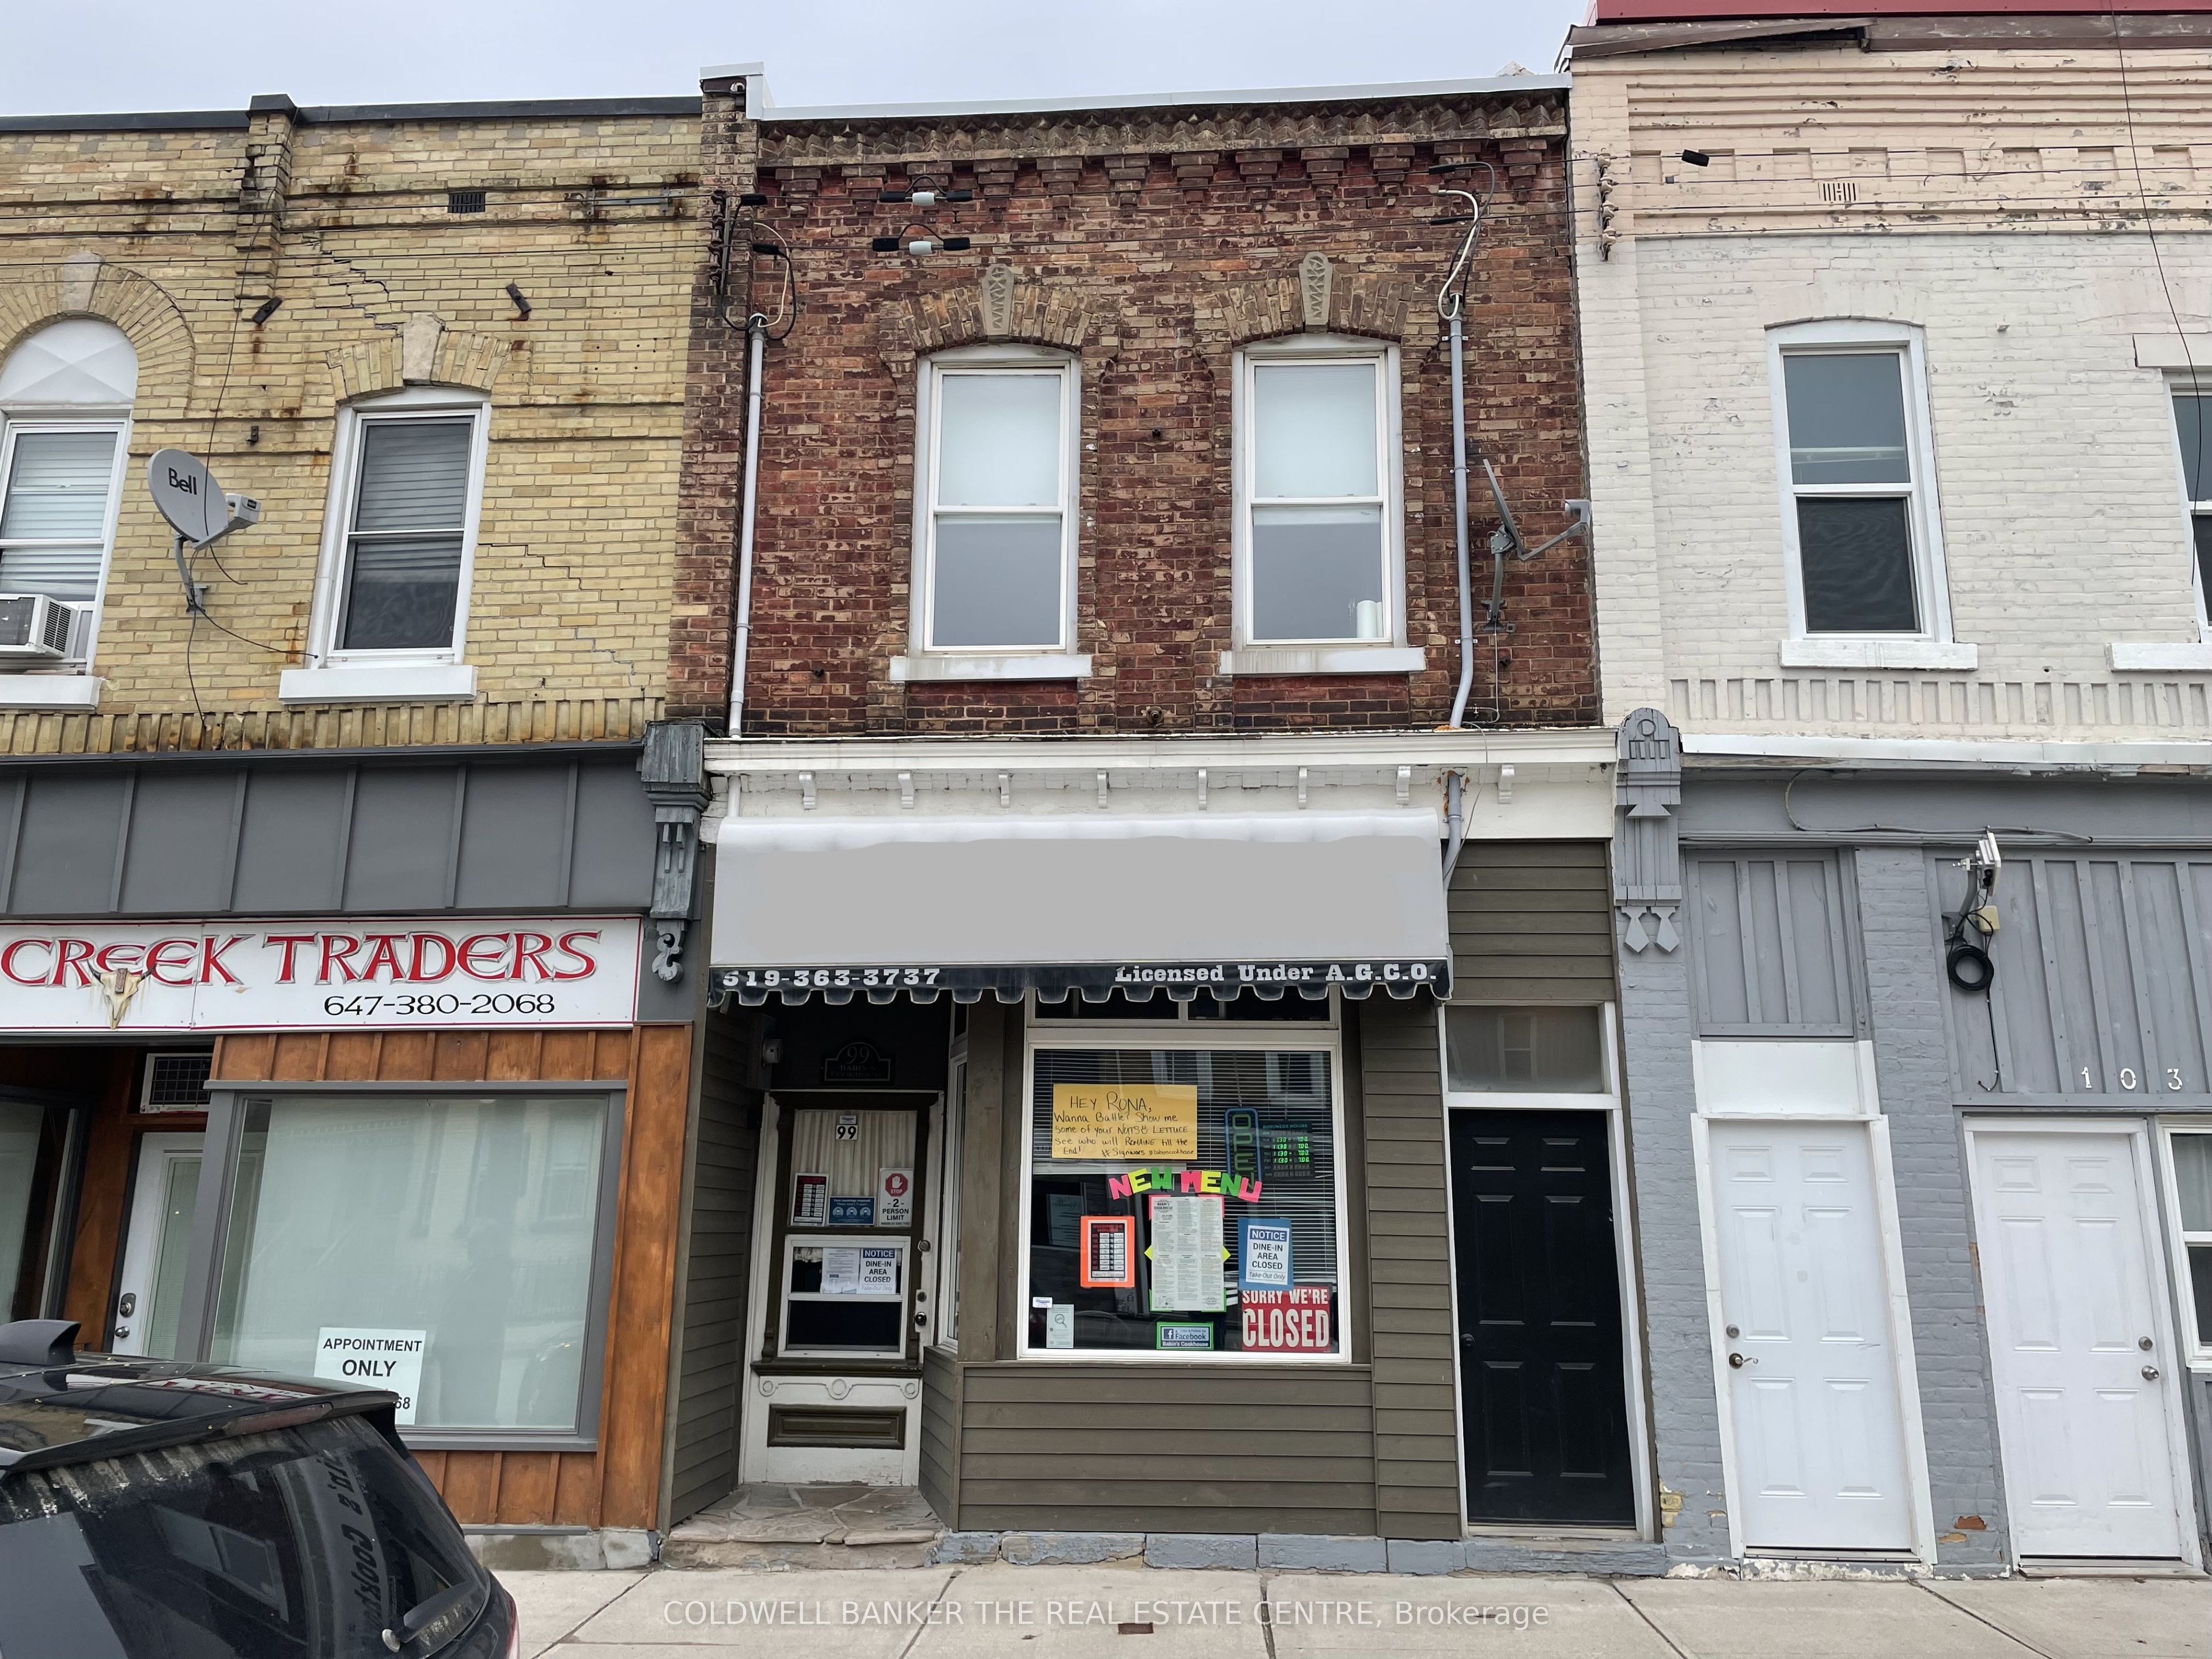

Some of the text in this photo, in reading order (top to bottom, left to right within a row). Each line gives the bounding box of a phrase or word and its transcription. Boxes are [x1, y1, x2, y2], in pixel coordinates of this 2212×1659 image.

[168, 467, 197, 495] Bell
[0, 929, 602, 989] CREEK TRADERS
[723, 968, 940, 987] 519-363-3737
[1115, 963, 1437, 982] Licensed Under A.G.C.O.
[324, 994, 555, 1016] 647-380-2068
[846, 1046, 870, 1065] 99
[1070, 1091, 1152, 1112] HEY RONA,
[1054, 1111, 1089, 1122] Wanna
[1096, 1112, 1130, 1122] Battle?
[1135, 1112, 1160, 1122] Show
[837, 1126, 857, 1139] 99
[1081, 1124, 1090, 1134] of
[1094, 1127, 1113, 1137] your
[1153, 1125, 1188, 1134] LETTUCE
[1078, 1137, 1096, 1145] who
[1102, 1137, 1118, 1145] will
[1126, 1137, 1156, 1145] ROMAINE
[1162, 1137, 1172, 1145] till
[1176, 1137, 1188, 1145] the
[1063, 1146, 1081, 1154] End!
[1109, 1167, 1263, 1203] NEW MENU
[1252, 1230, 1286, 1241] NOTICE
[1253, 1243, 1283, 1252] DINE-IN
[1257, 1252, 1278, 1260] AREA
[1252, 1261, 1283, 1270] CLOSED
[1249, 1271, 1273, 1279] Take-Out
[1242, 1289, 1328, 1304] SORRY WE'RE
[1243, 1308, 1330, 1347] CLOSED
[323, 1338, 422, 1352] APPOINTMENT
[342, 1359, 397, 1377] ONLY
